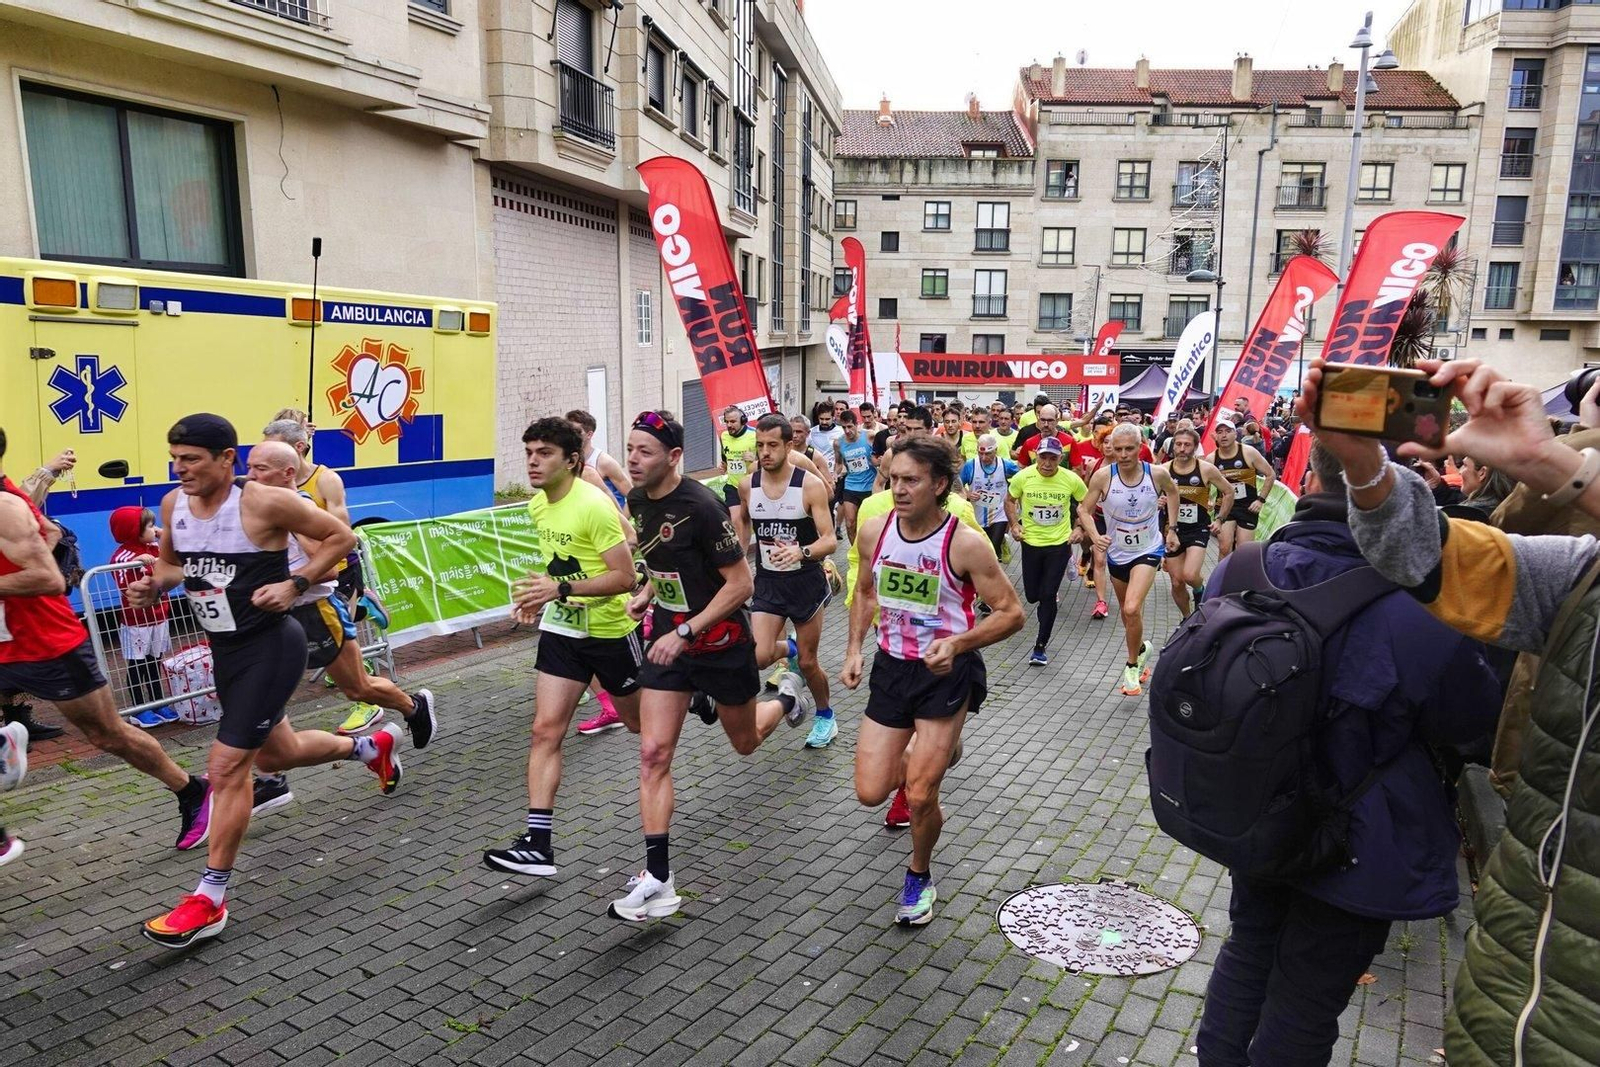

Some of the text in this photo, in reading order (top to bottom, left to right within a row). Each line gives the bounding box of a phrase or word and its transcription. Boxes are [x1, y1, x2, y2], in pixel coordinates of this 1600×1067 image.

[331, 305, 426, 324] AMBULANCIA
[1235, 326, 1278, 388] RUN
[1167, 332, 1211, 405] Atlántico
[730, 462, 743, 470] 215
[852, 461, 863, 469] 98
[1038, 509, 1059, 519] 134
[1180, 509, 1193, 517] 52
[1124, 534, 1140, 545] 61
[440, 566, 465, 583] máis
[887, 572, 929, 598] 554
